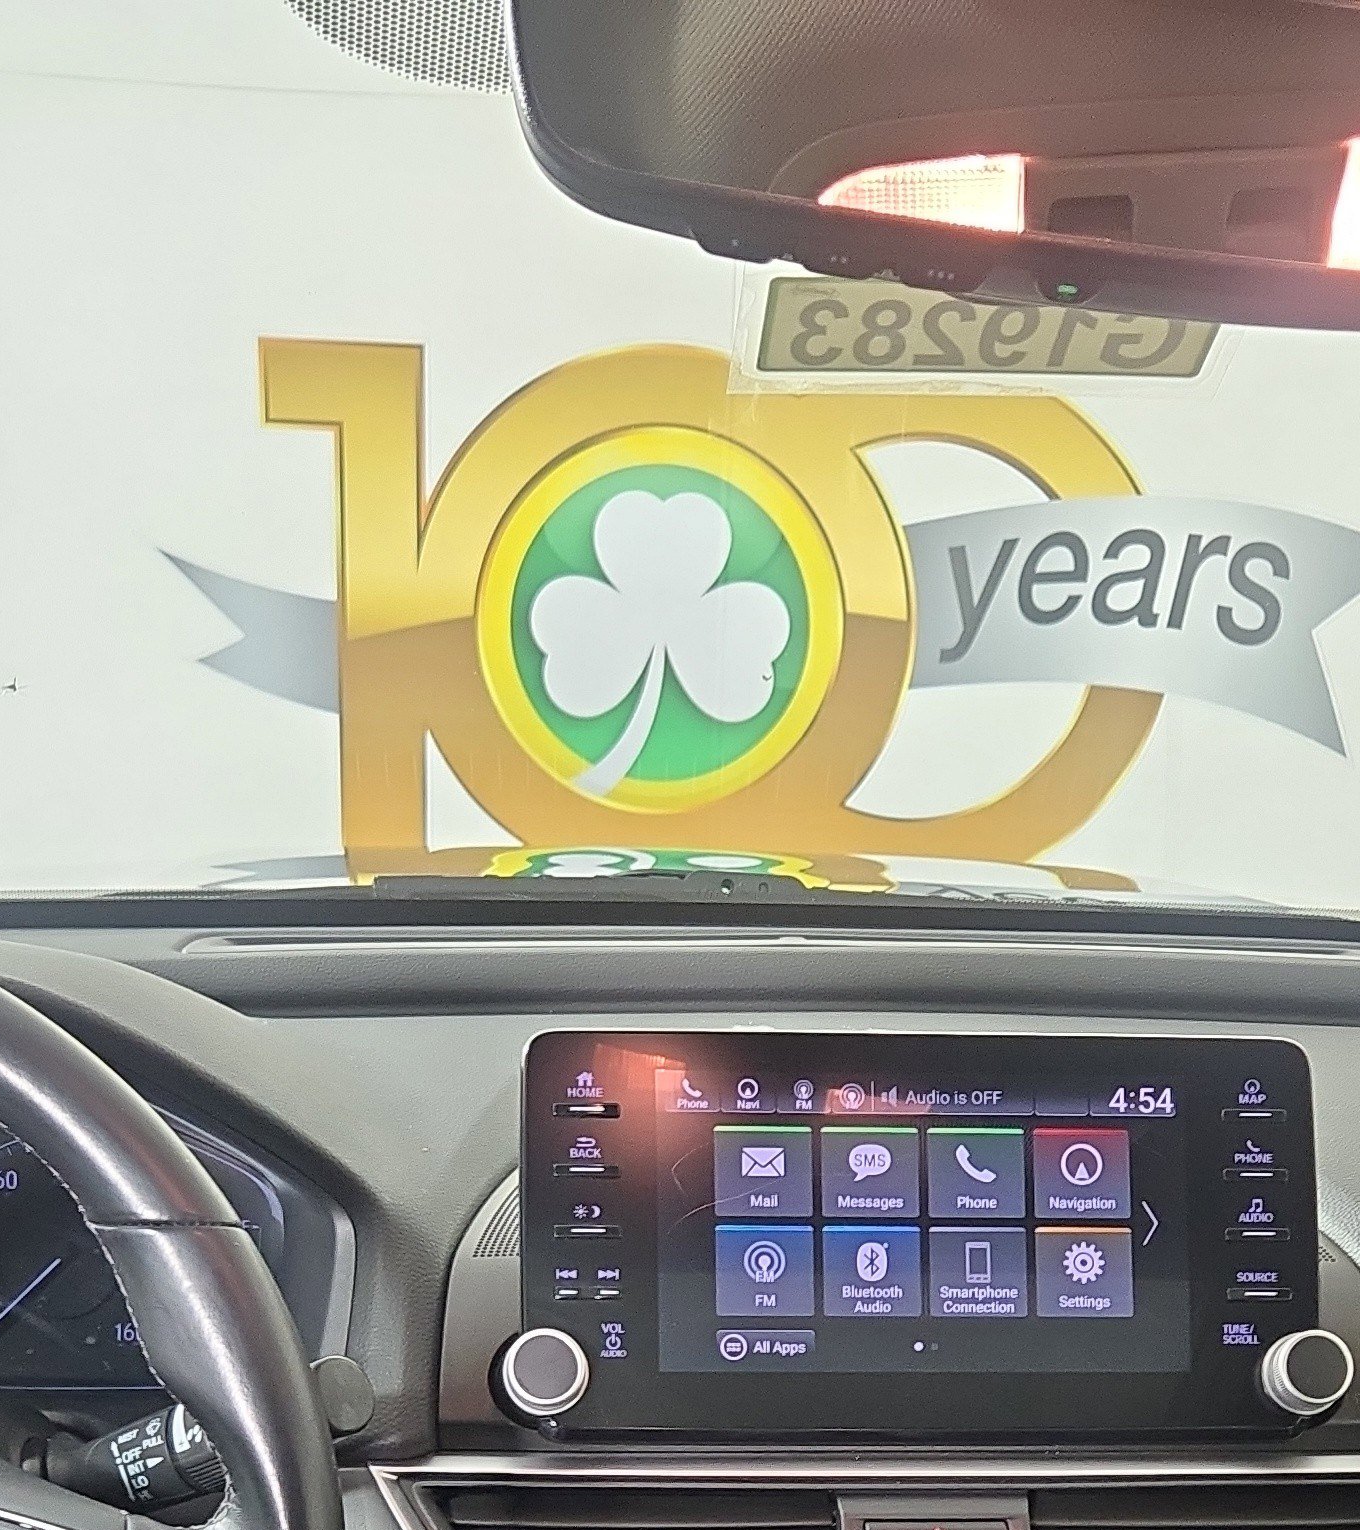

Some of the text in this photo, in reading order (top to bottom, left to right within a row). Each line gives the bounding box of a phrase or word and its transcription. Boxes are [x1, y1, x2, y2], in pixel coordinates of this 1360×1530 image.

[942, 526, 1291, 662] years
[567, 1087, 604, 1098] HOME
[905, 1090, 1003, 1105] Audio is OFF
[1238, 1094, 1266, 1104] MAP
[676, 1099, 709, 1110] Phone
[737, 1099, 760, 1110] Navi
[795, 1100, 813, 1110] FM
[1108, 1087, 1175, 1114] 4:54
[569, 1147, 602, 1159] BACK
[1234, 1153, 1273, 1164] PHONE
[854, 1153, 886, 1167] SMS
[750, 1194, 778, 1208] Mail
[838, 1195, 904, 1211] Messages
[956, 1196, 998, 1210] Phone
[1049, 1196, 1116, 1212] Navigation
[1238, 1212, 1274, 1223] AUDIO
[1236, 1272, 1279, 1283] SOURCE
[842, 1285, 903, 1298] Bluetooth
[940, 1286, 1019, 1301] Smartphone
[755, 1295, 776, 1308] FM
[854, 1300, 892, 1313] Audio
[943, 1301, 1015, 1314] Connection
[1059, 1295, 1111, 1311] Settings
[601, 1323, 625, 1334] VOL
[1222, 1324, 1255, 1335] TUNE/
[1222, 1334, 1260, 1346] SCROLL
[600, 1348, 627, 1358] AUDIO
[753, 1341, 807, 1356] All Apps
[142, 1435, 165, 1450] PULL
[122, 1446, 143, 1464] OFF
